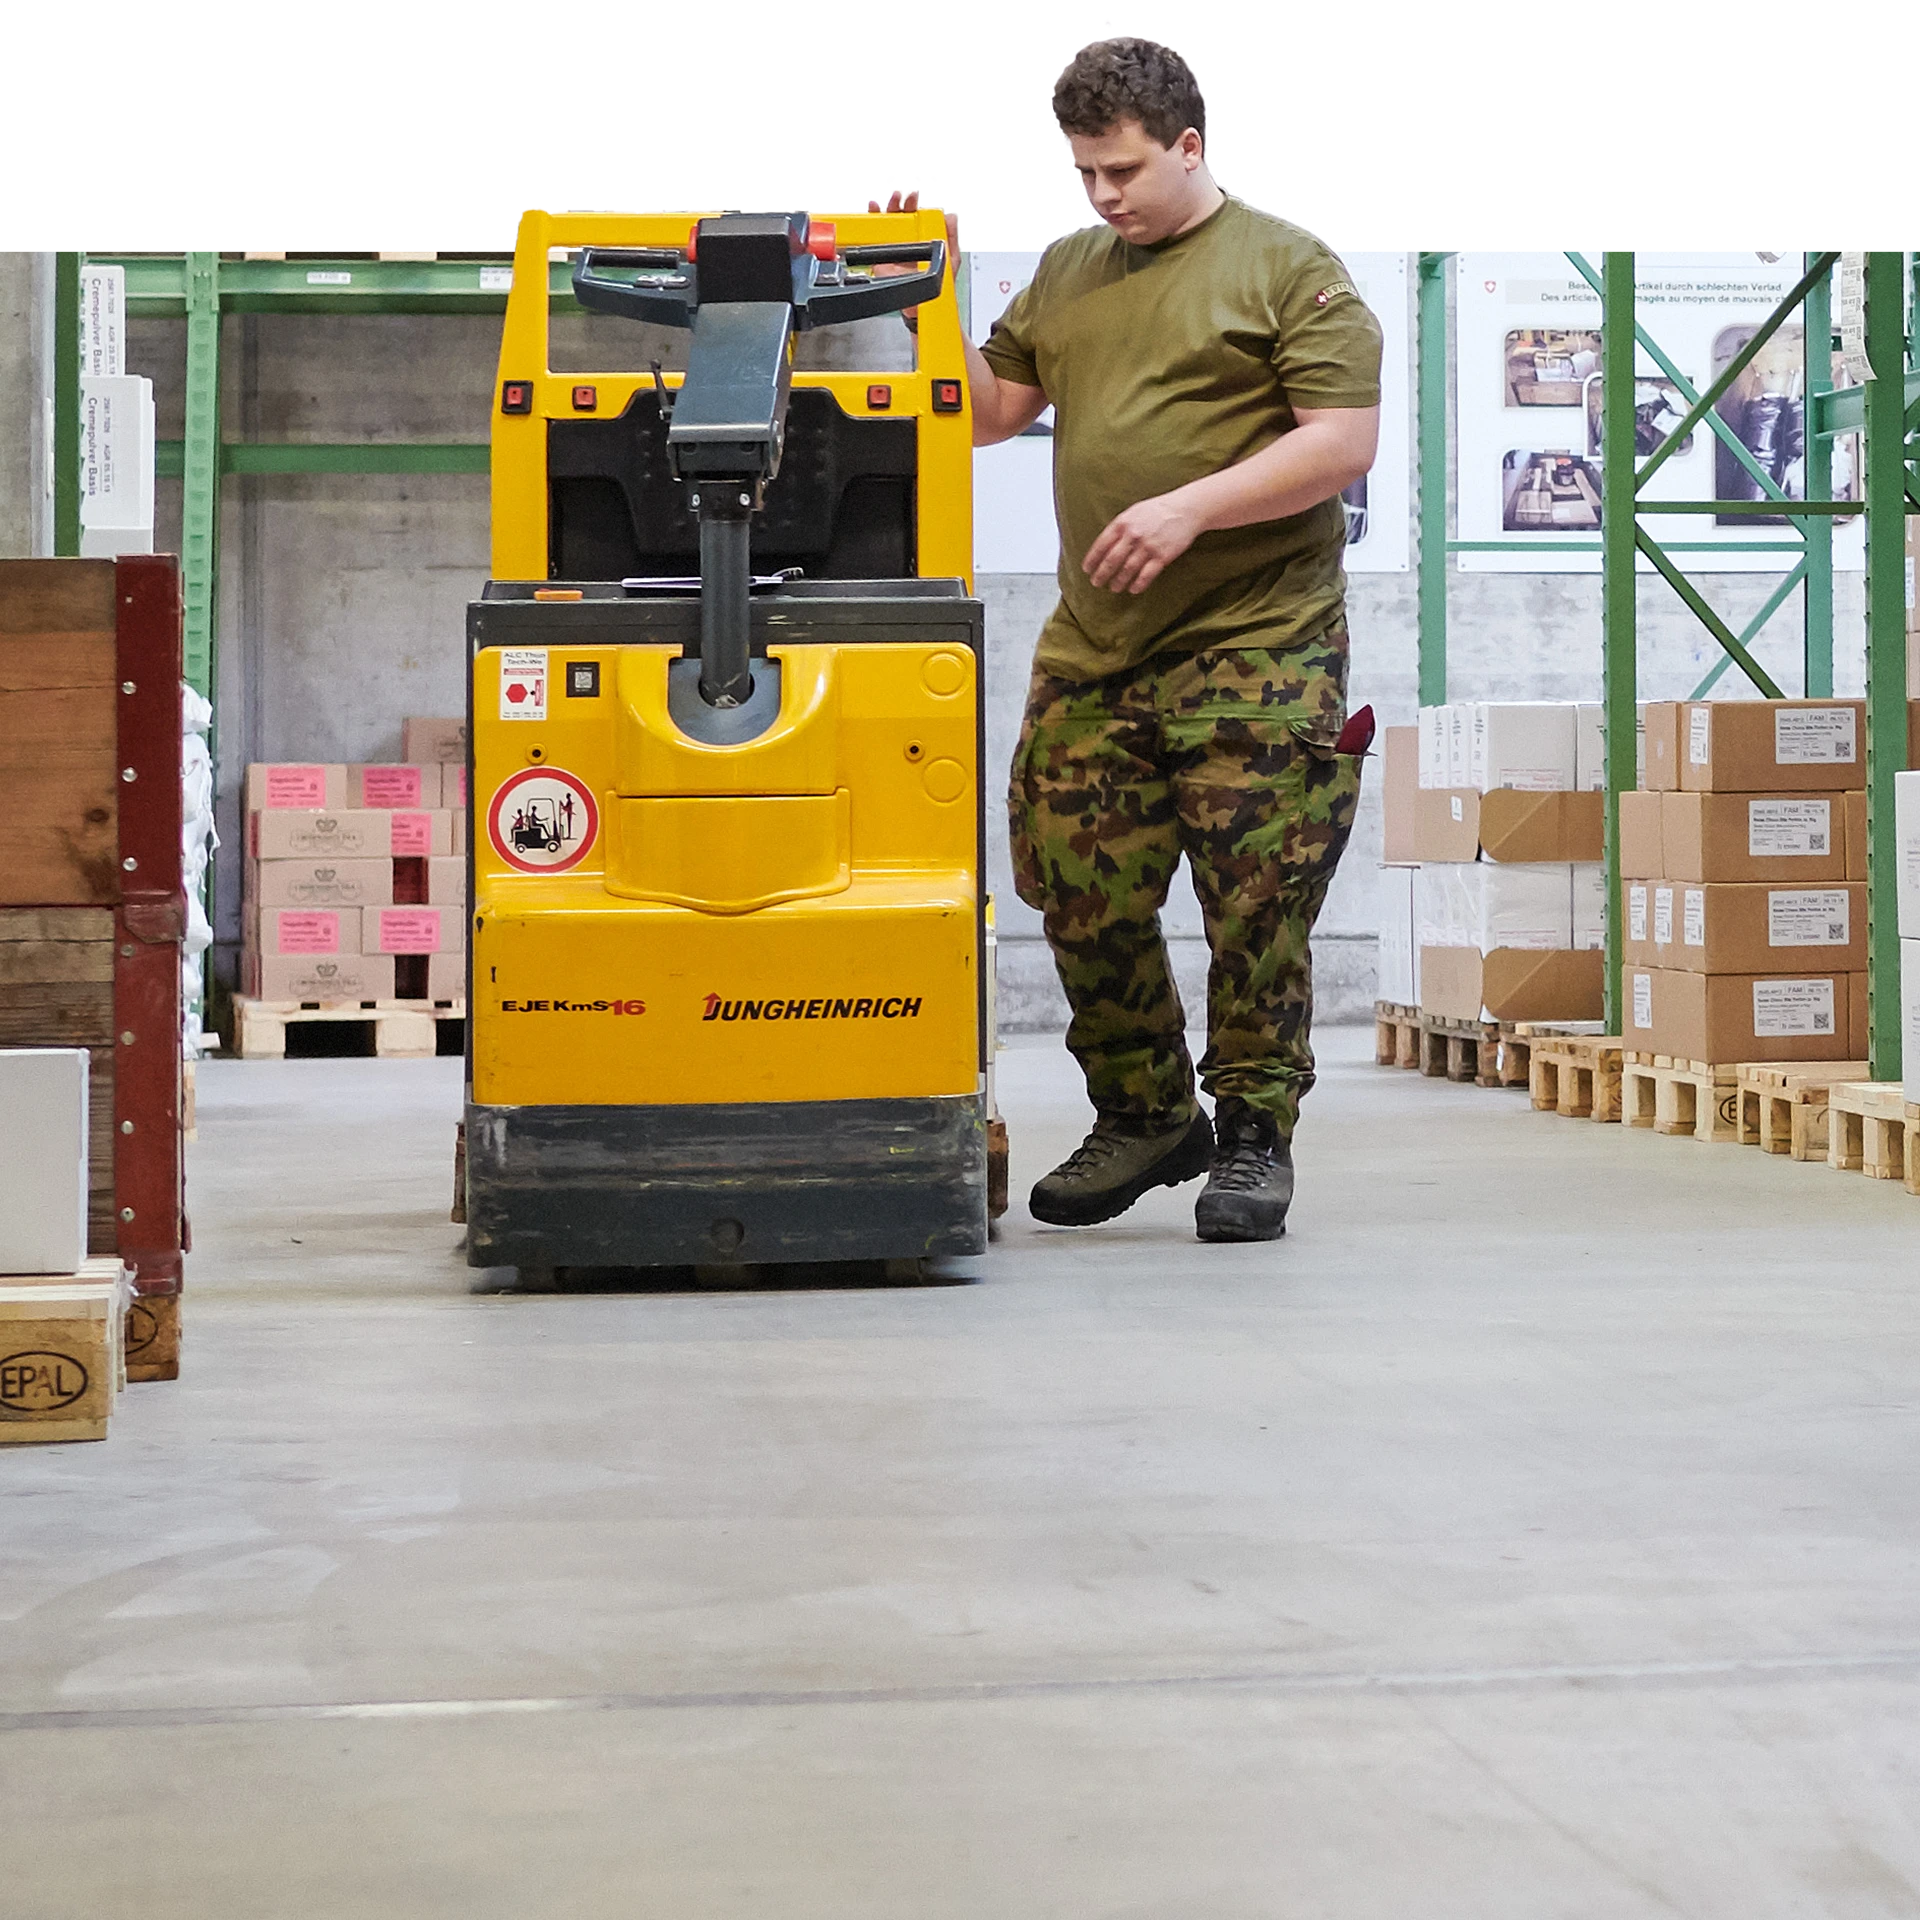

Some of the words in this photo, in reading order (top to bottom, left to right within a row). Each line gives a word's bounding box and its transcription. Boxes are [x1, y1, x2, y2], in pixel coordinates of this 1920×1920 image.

[1541, 293, 1560, 301] Des
[1563, 293, 1598, 302] articles
[1683, 295, 1716, 304] moyen
[1718, 293, 1730, 302] de
[1733, 293, 1773, 302] mauvais
[1635, 281, 1664, 290] rtikel
[1665, 282, 1694, 291] durch
[1696, 282, 1748, 291] schlechten
[1751, 282, 1782, 291] Verlad
[91, 278, 102, 346] Cremepulver
[87, 397, 98, 464] Cremepulver
[88, 467, 98, 497] Basis
[702, 996, 923, 1021] JUNGHEINRICH
[0, 1365, 74, 1399] EPAL
